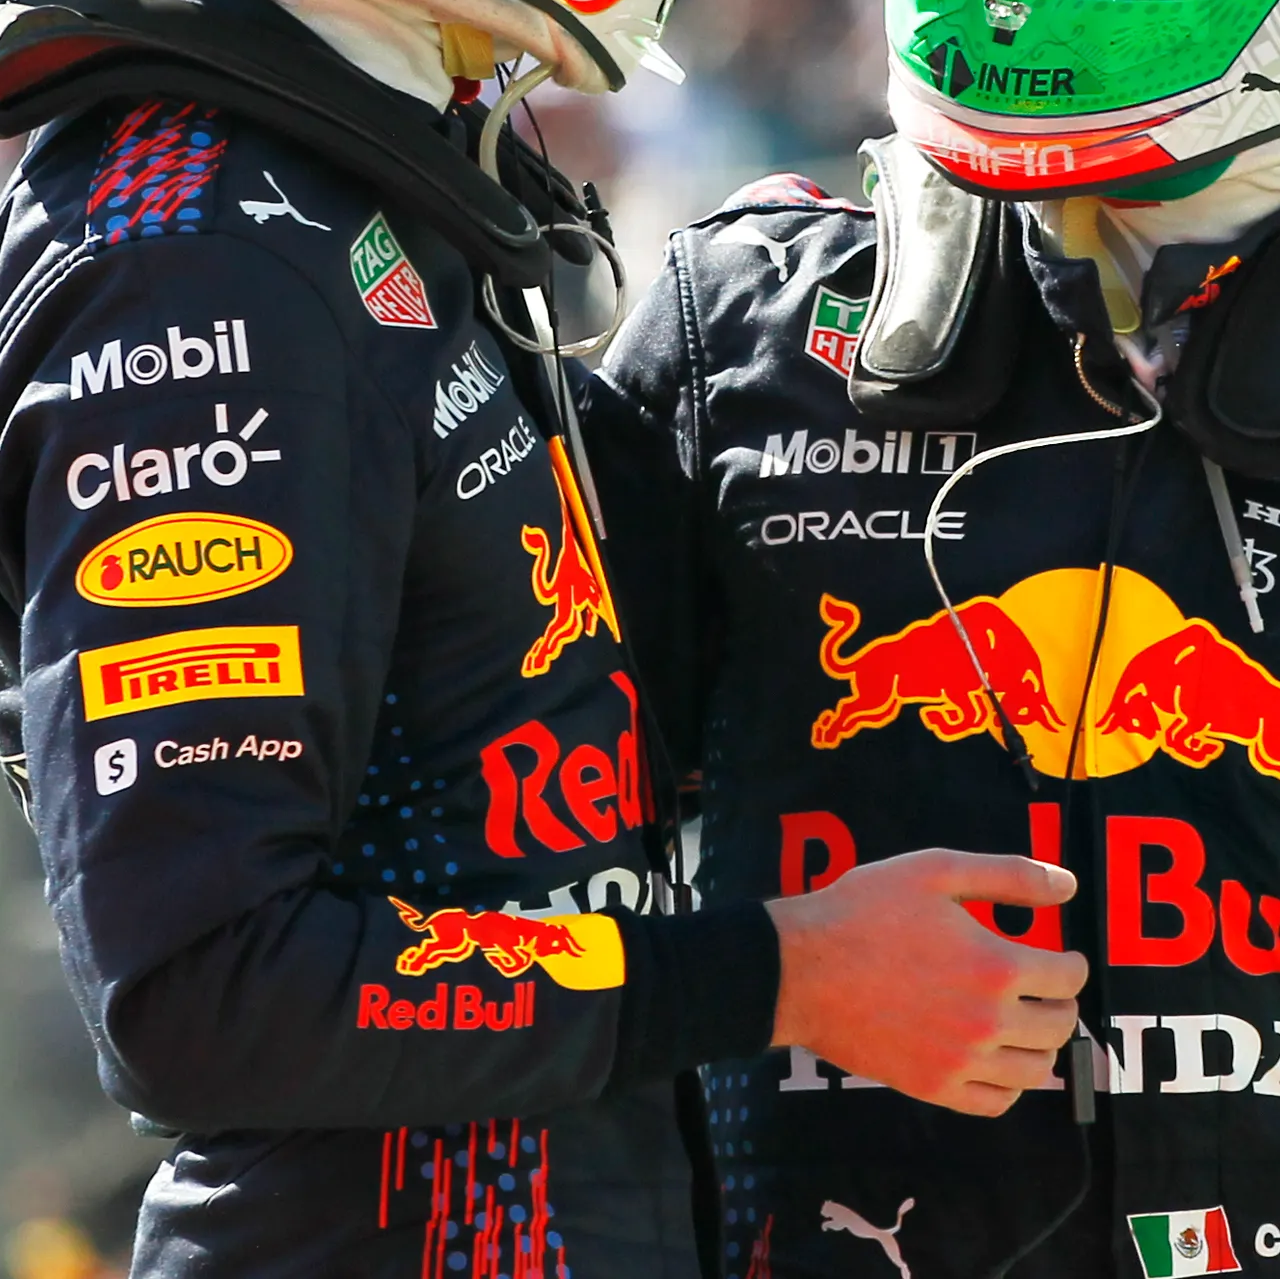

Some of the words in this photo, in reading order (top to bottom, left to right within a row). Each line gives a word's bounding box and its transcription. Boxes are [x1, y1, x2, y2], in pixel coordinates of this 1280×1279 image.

[976, 62, 1076, 97] INTER
[352, 224, 398, 285] TAG
[369, 267, 428, 324] HEUER
[70, 319, 251, 401] Mobil
[432, 351, 497, 440] Mobil
[66, 442, 250, 511] Claro
[456, 415, 536, 500] ORACLE
[759, 428, 913, 478] Mobil
[761, 509, 967, 546] ORACLE
[128, 535, 263, 584] RAUCH
[100, 642, 281, 706] PIRELLI
[154, 736, 230, 769] Cash
[235, 734, 303, 762] App
[479, 670, 646, 858] Red
[356, 981, 449, 1031] Red
[453, 980, 536, 1032] Bull
